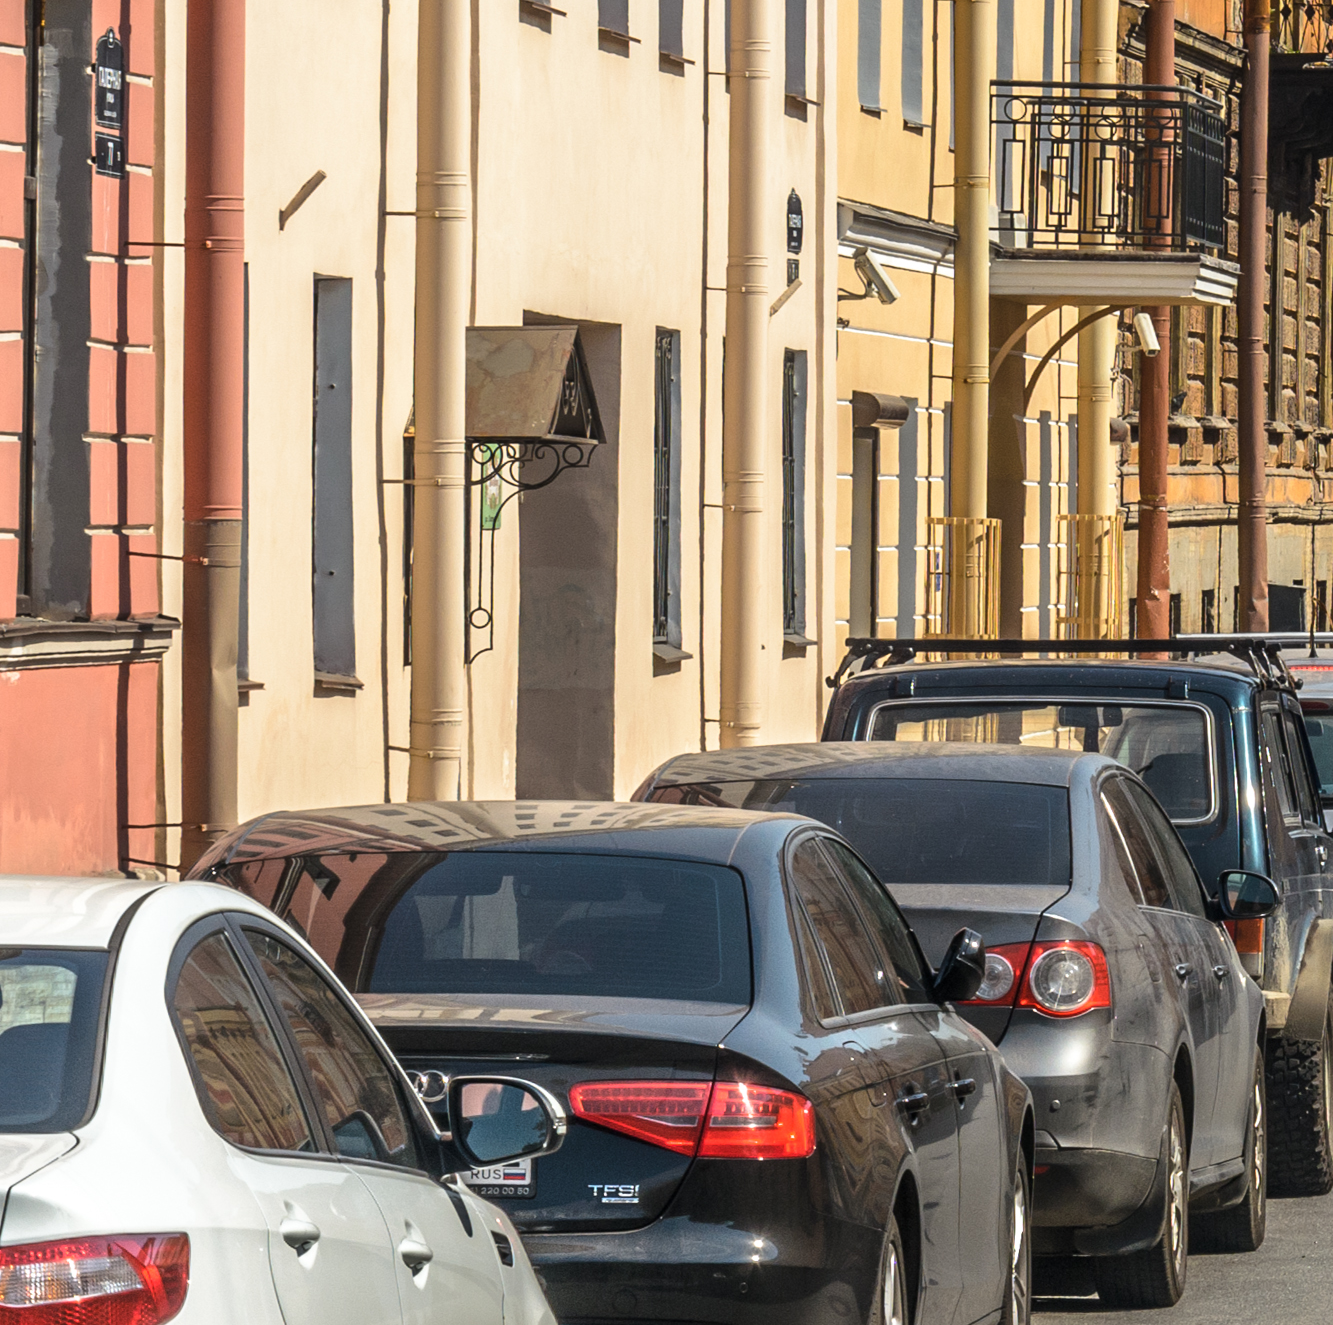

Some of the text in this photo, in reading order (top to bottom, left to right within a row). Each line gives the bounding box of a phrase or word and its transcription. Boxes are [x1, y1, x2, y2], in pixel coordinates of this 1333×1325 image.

[471, 1169, 502, 1180] RUS
[481, 1187, 500, 1195] 220
[502, 1187, 514, 1195] 00
[517, 1187, 530, 1195] 50
[587, 1184, 640, 1197] TFSI
